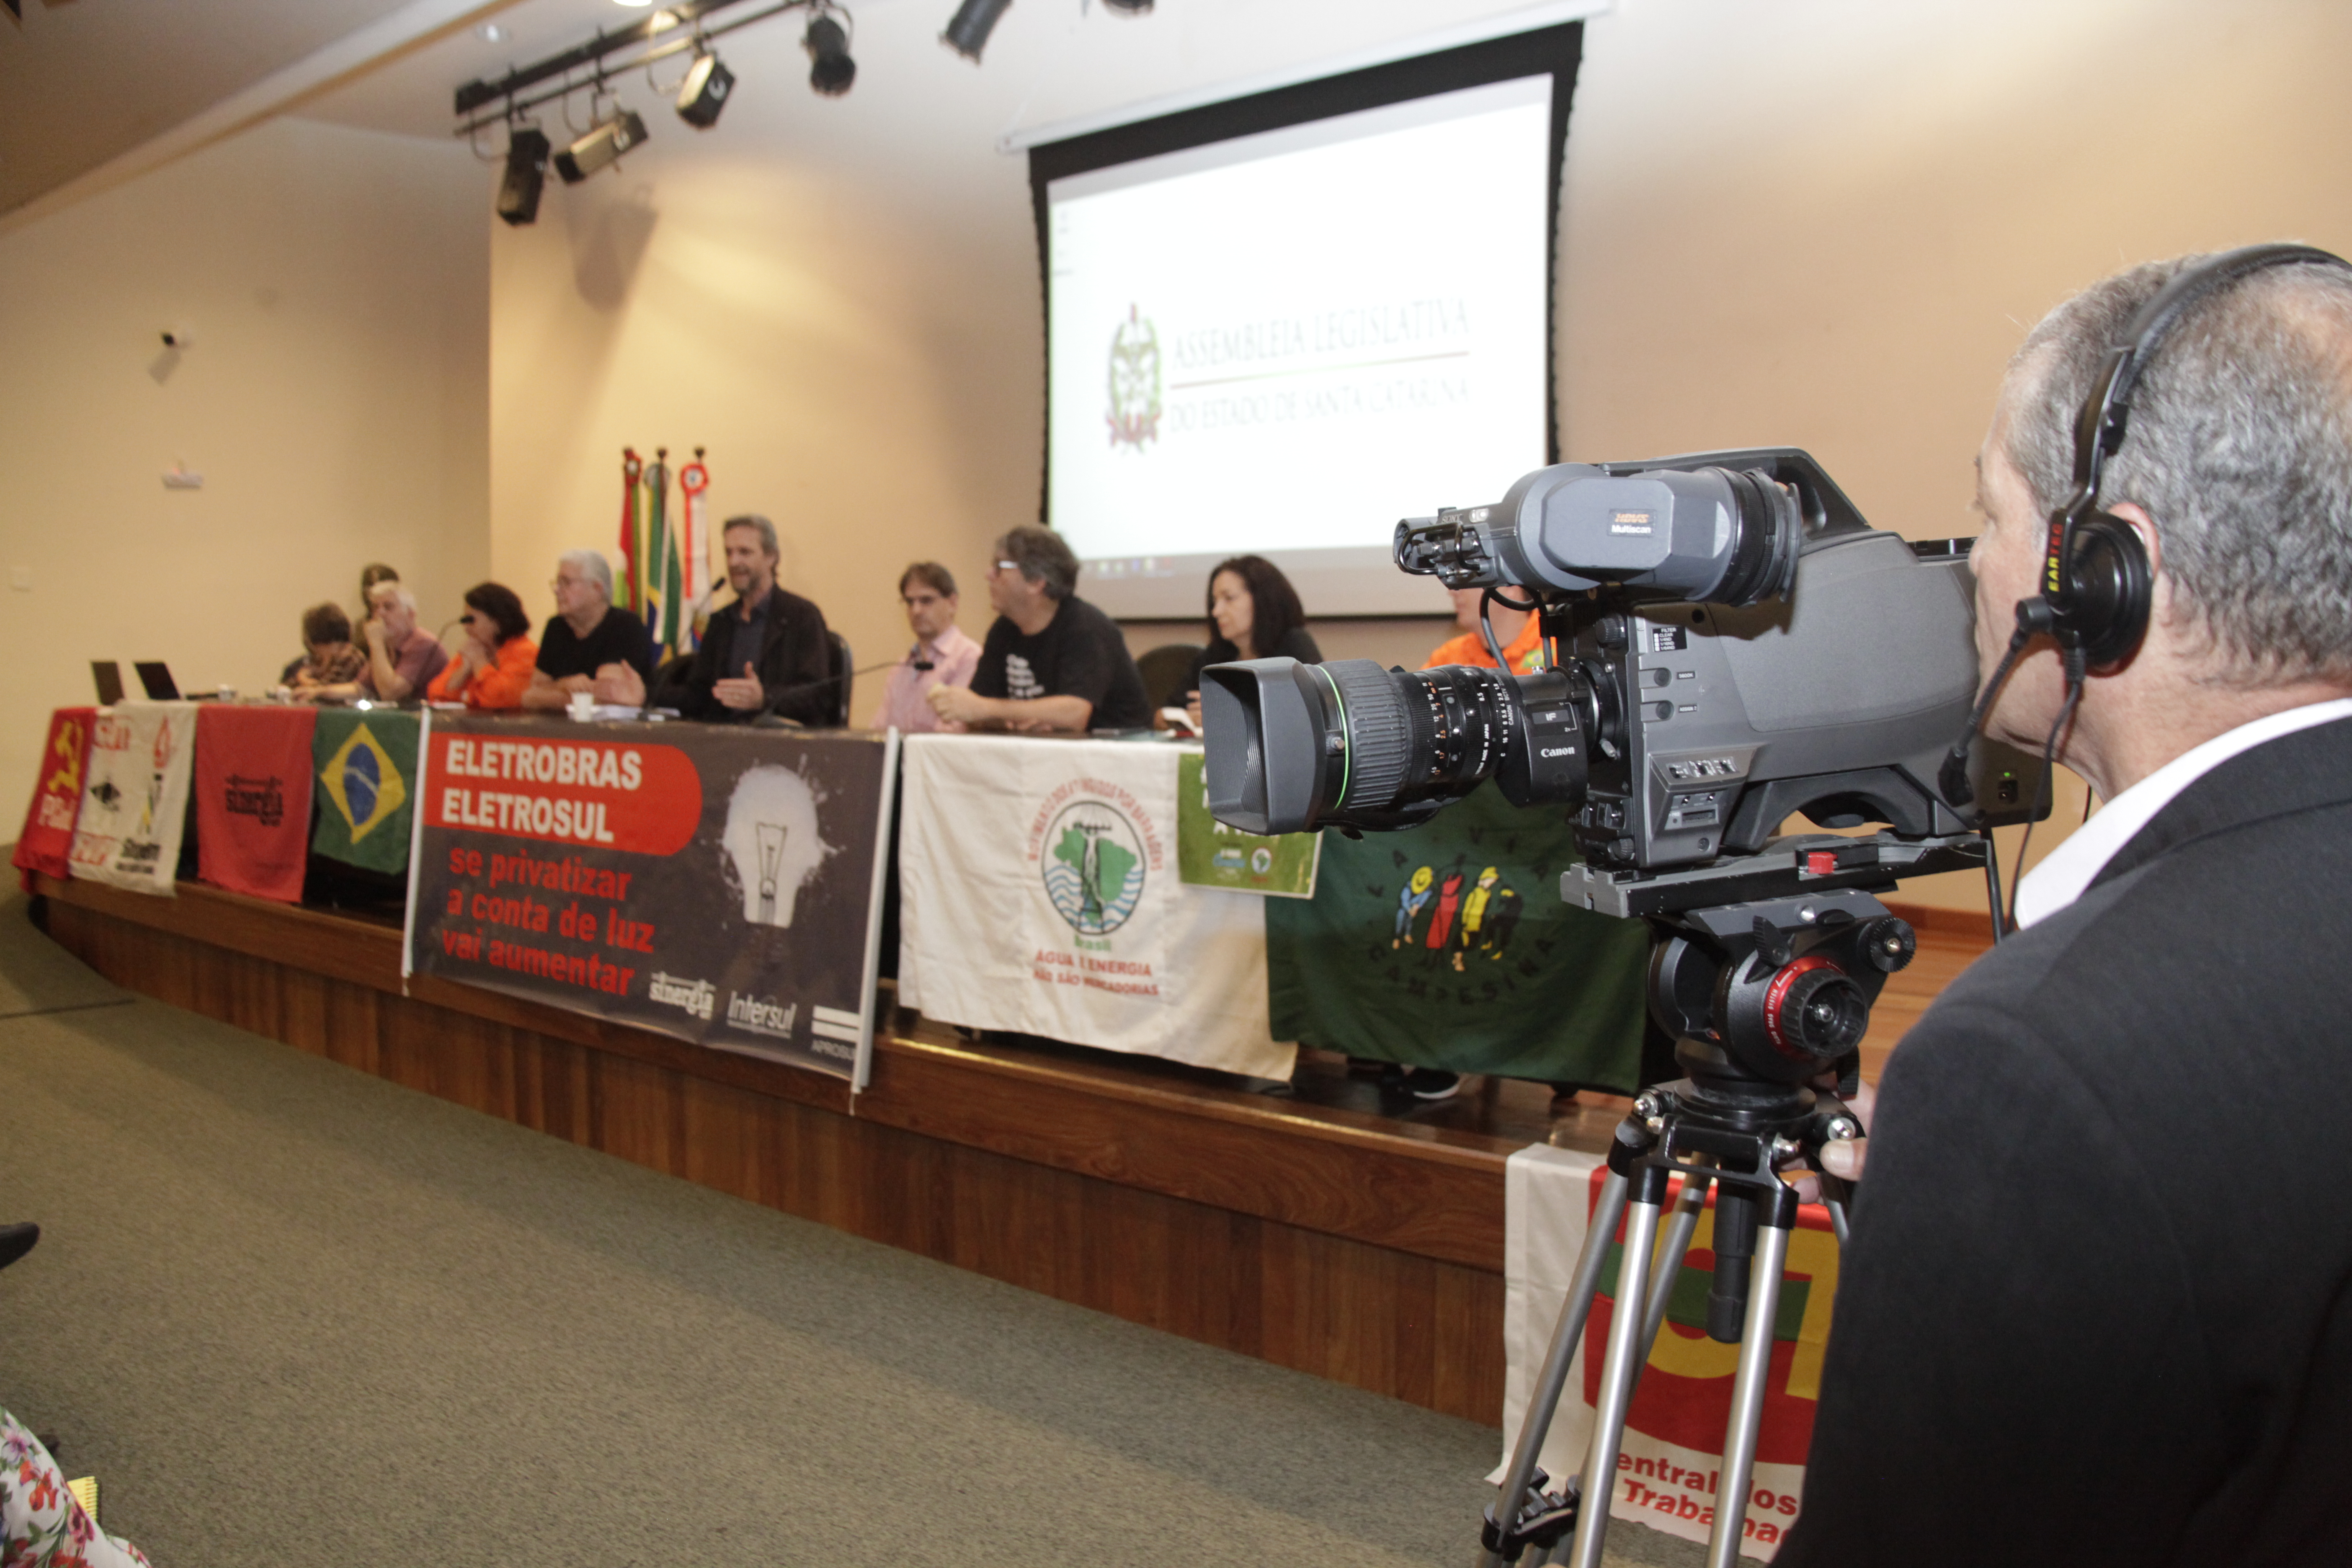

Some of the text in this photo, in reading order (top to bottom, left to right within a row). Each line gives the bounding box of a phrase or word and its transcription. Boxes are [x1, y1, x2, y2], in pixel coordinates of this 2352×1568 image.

[1172, 296, 1470, 371] ASSEMBLEIA LEGISLATIVA
[1169, 401, 1197, 434] DO
[1201, 393, 1269, 430] ESTADO
[1274, 391, 1297, 423] DE
[1304, 384, 1363, 419] SANTA
[1442, 514, 1462, 523] SONY
[1612, 525, 1651, 533] Multiscan
[1494, 675, 1505, 686] ZOOM
[1501, 687, 1510, 701] BCTV
[1477, 692, 1485, 701] 8.5
[446, 739, 642, 790] ELETROBRAS
[1540, 747, 1575, 758] Canon
[442, 788, 614, 843] ELETROSUL
[449, 846, 632, 902] se privatizar
[446, 890, 655, 954] a conta de luz
[441, 928, 636, 997] vai aumentar
[1088, 958, 1151, 977] ENERGIA
[1768, 989, 1778, 1010] SYSTEM
[1617, 1452, 1718, 1494] entral
